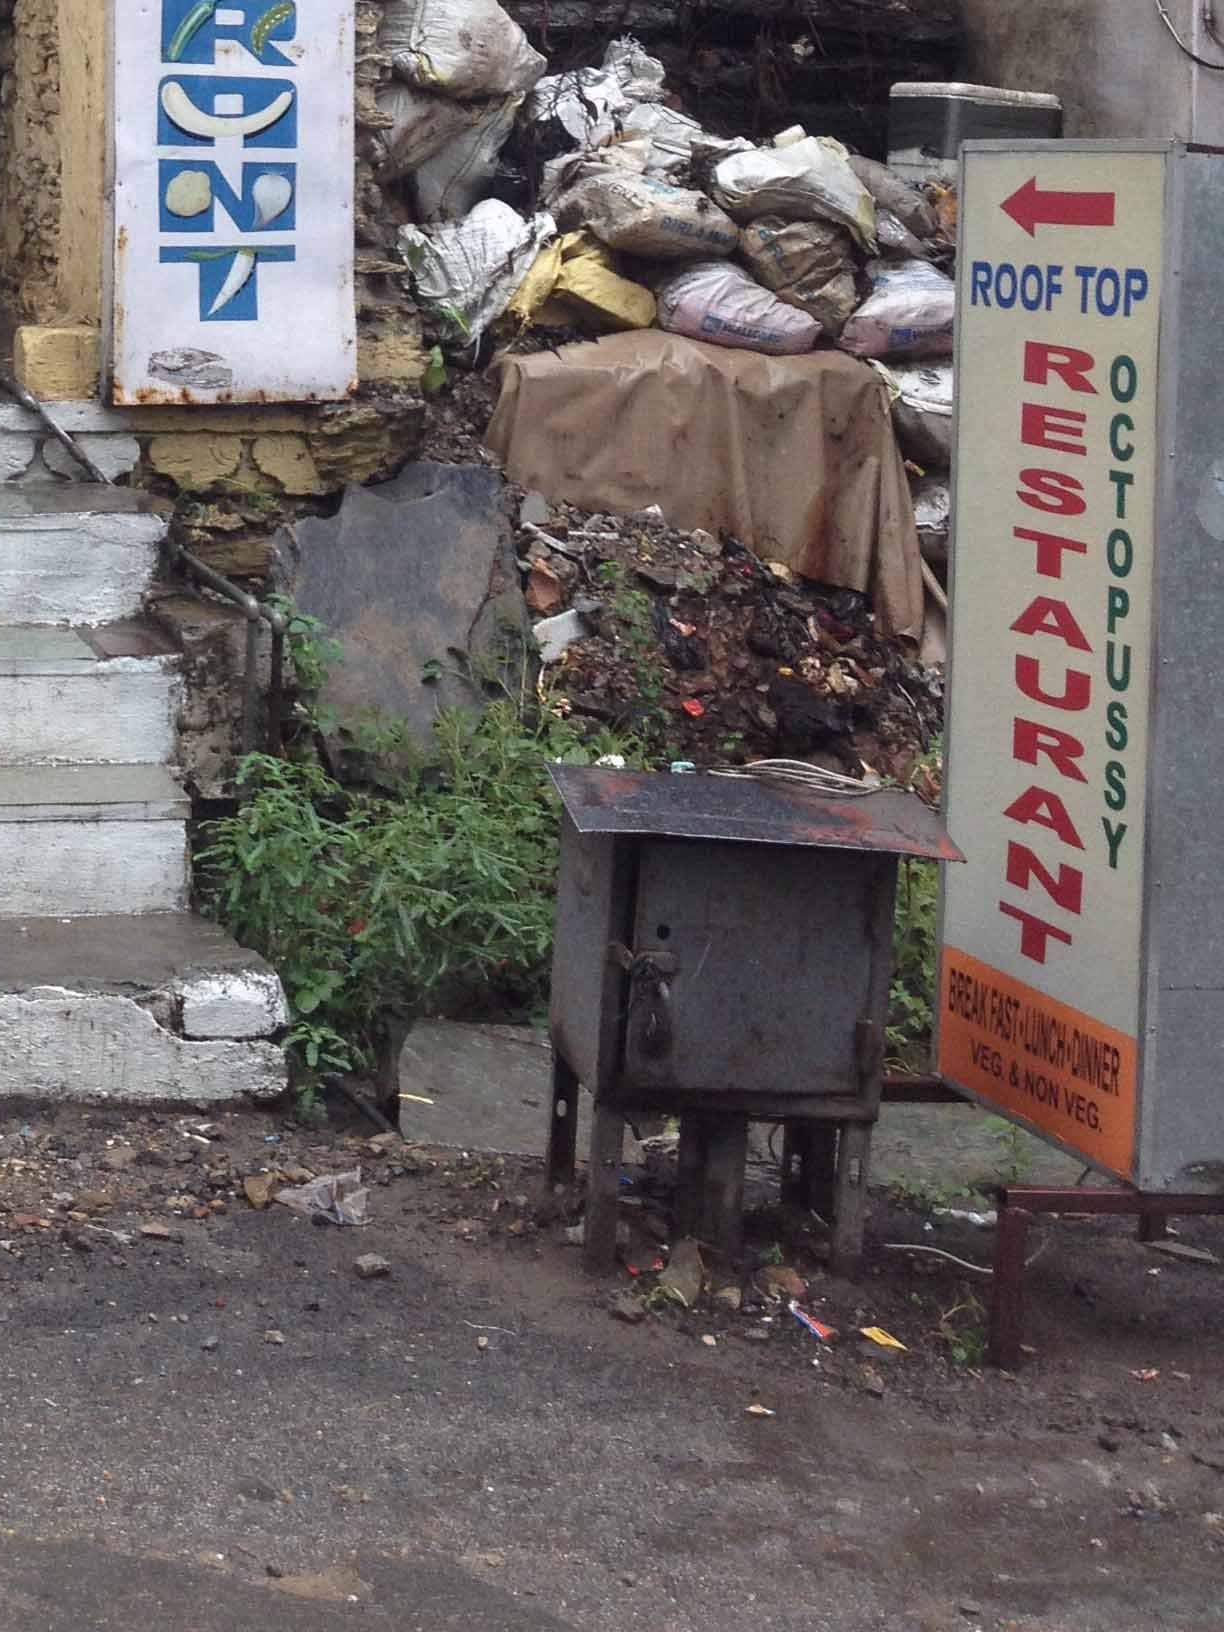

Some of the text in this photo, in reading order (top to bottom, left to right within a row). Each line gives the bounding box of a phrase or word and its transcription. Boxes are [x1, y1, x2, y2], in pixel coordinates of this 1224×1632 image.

[970, 261, 1149, 317] ROOF TOP
[998, 341, 1099, 965] RESTAURANT
[1101, 355, 1138, 869] OCTOPUSSY
[970, 1037, 1103, 1133] VEG. & NON VEG.
